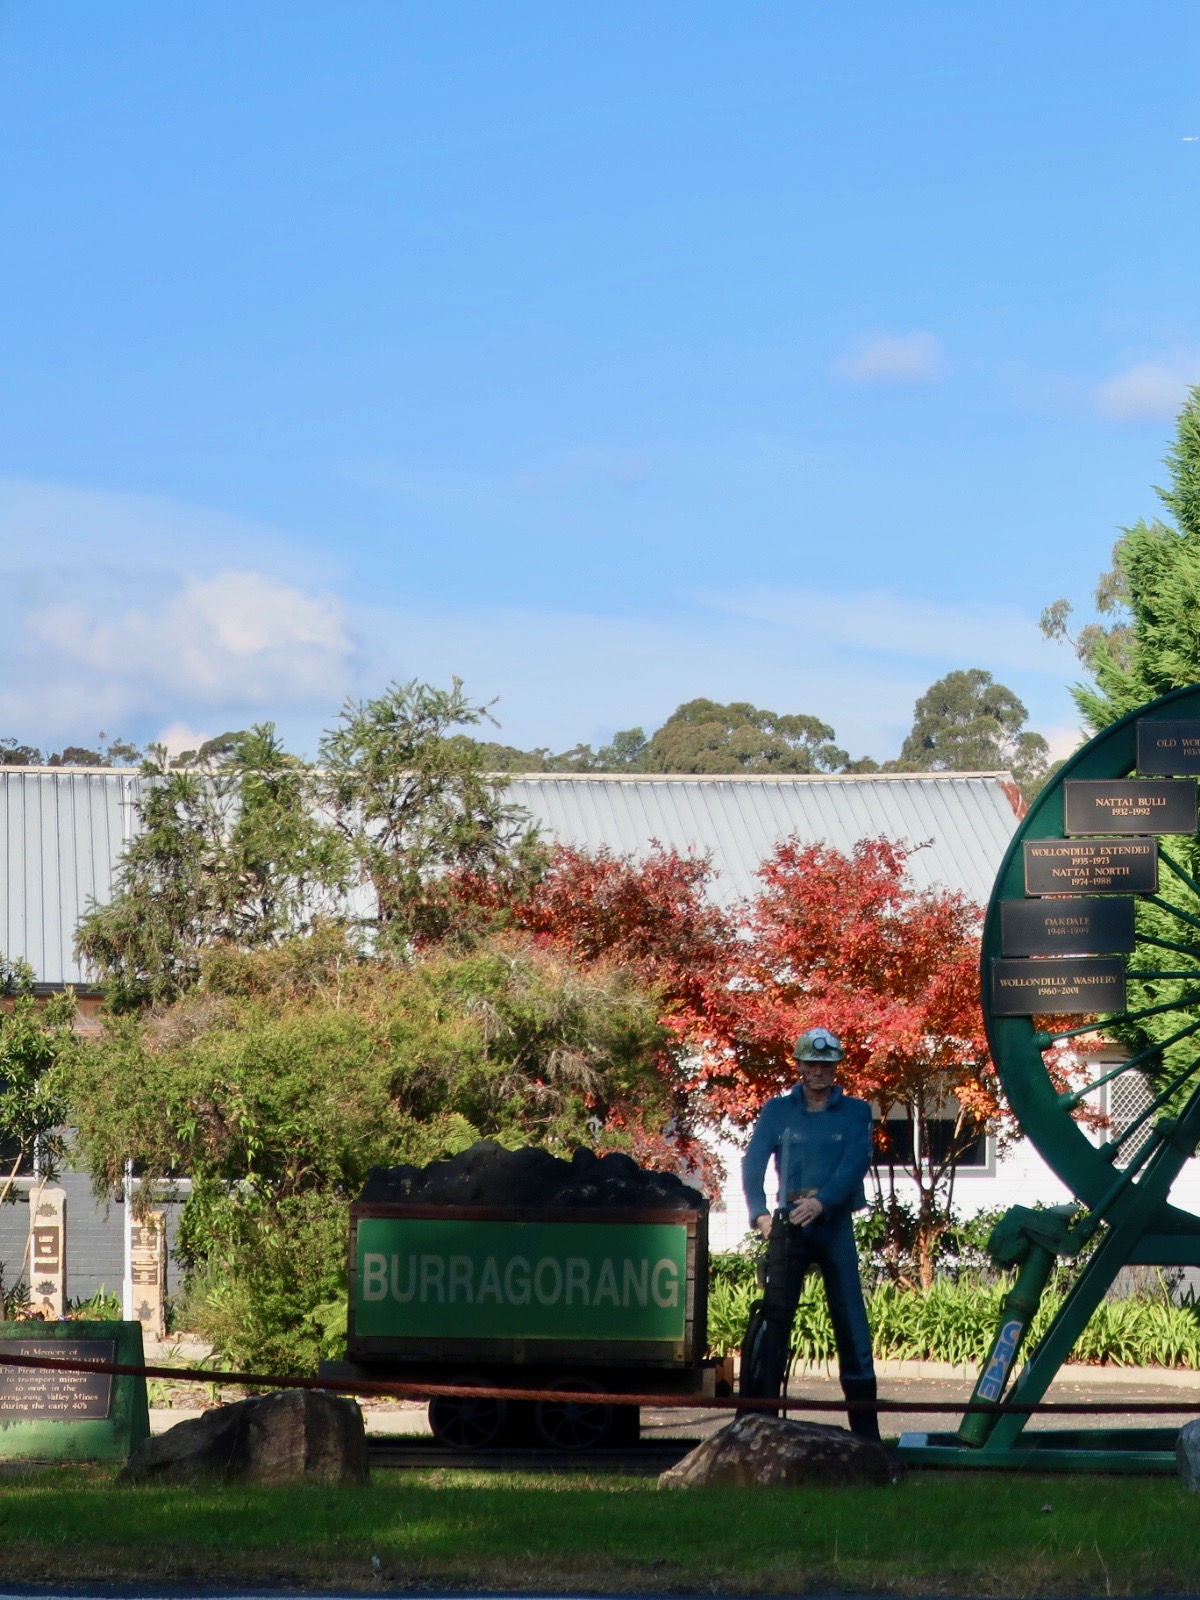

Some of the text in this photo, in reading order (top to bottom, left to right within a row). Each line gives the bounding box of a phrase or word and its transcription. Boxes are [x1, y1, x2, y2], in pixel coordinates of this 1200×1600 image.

[1156, 739, 1177, 747] OLD
[1096, 798, 1166, 807] NATTAI BULLI
[1112, 808, 1150, 816] 1932-1992
[1031, 846, 1150, 857] WOLLONDILLY EXTENDED
[1071, 857, 1110, 865] 1935-1973
[1052, 867, 1130, 877] NATTAI NORTH
[1071, 877, 1111, 885] 1974-1988
[1044, 917, 1090, 926] OAKDALE
[1000, 976, 1117, 987] WOLLONDILLY WASHERY
[363, 1253, 679, 1308] BURRAGORANG
[47, 1393, 70, 1401] Valley
[48, 1403, 69, 1411] early
